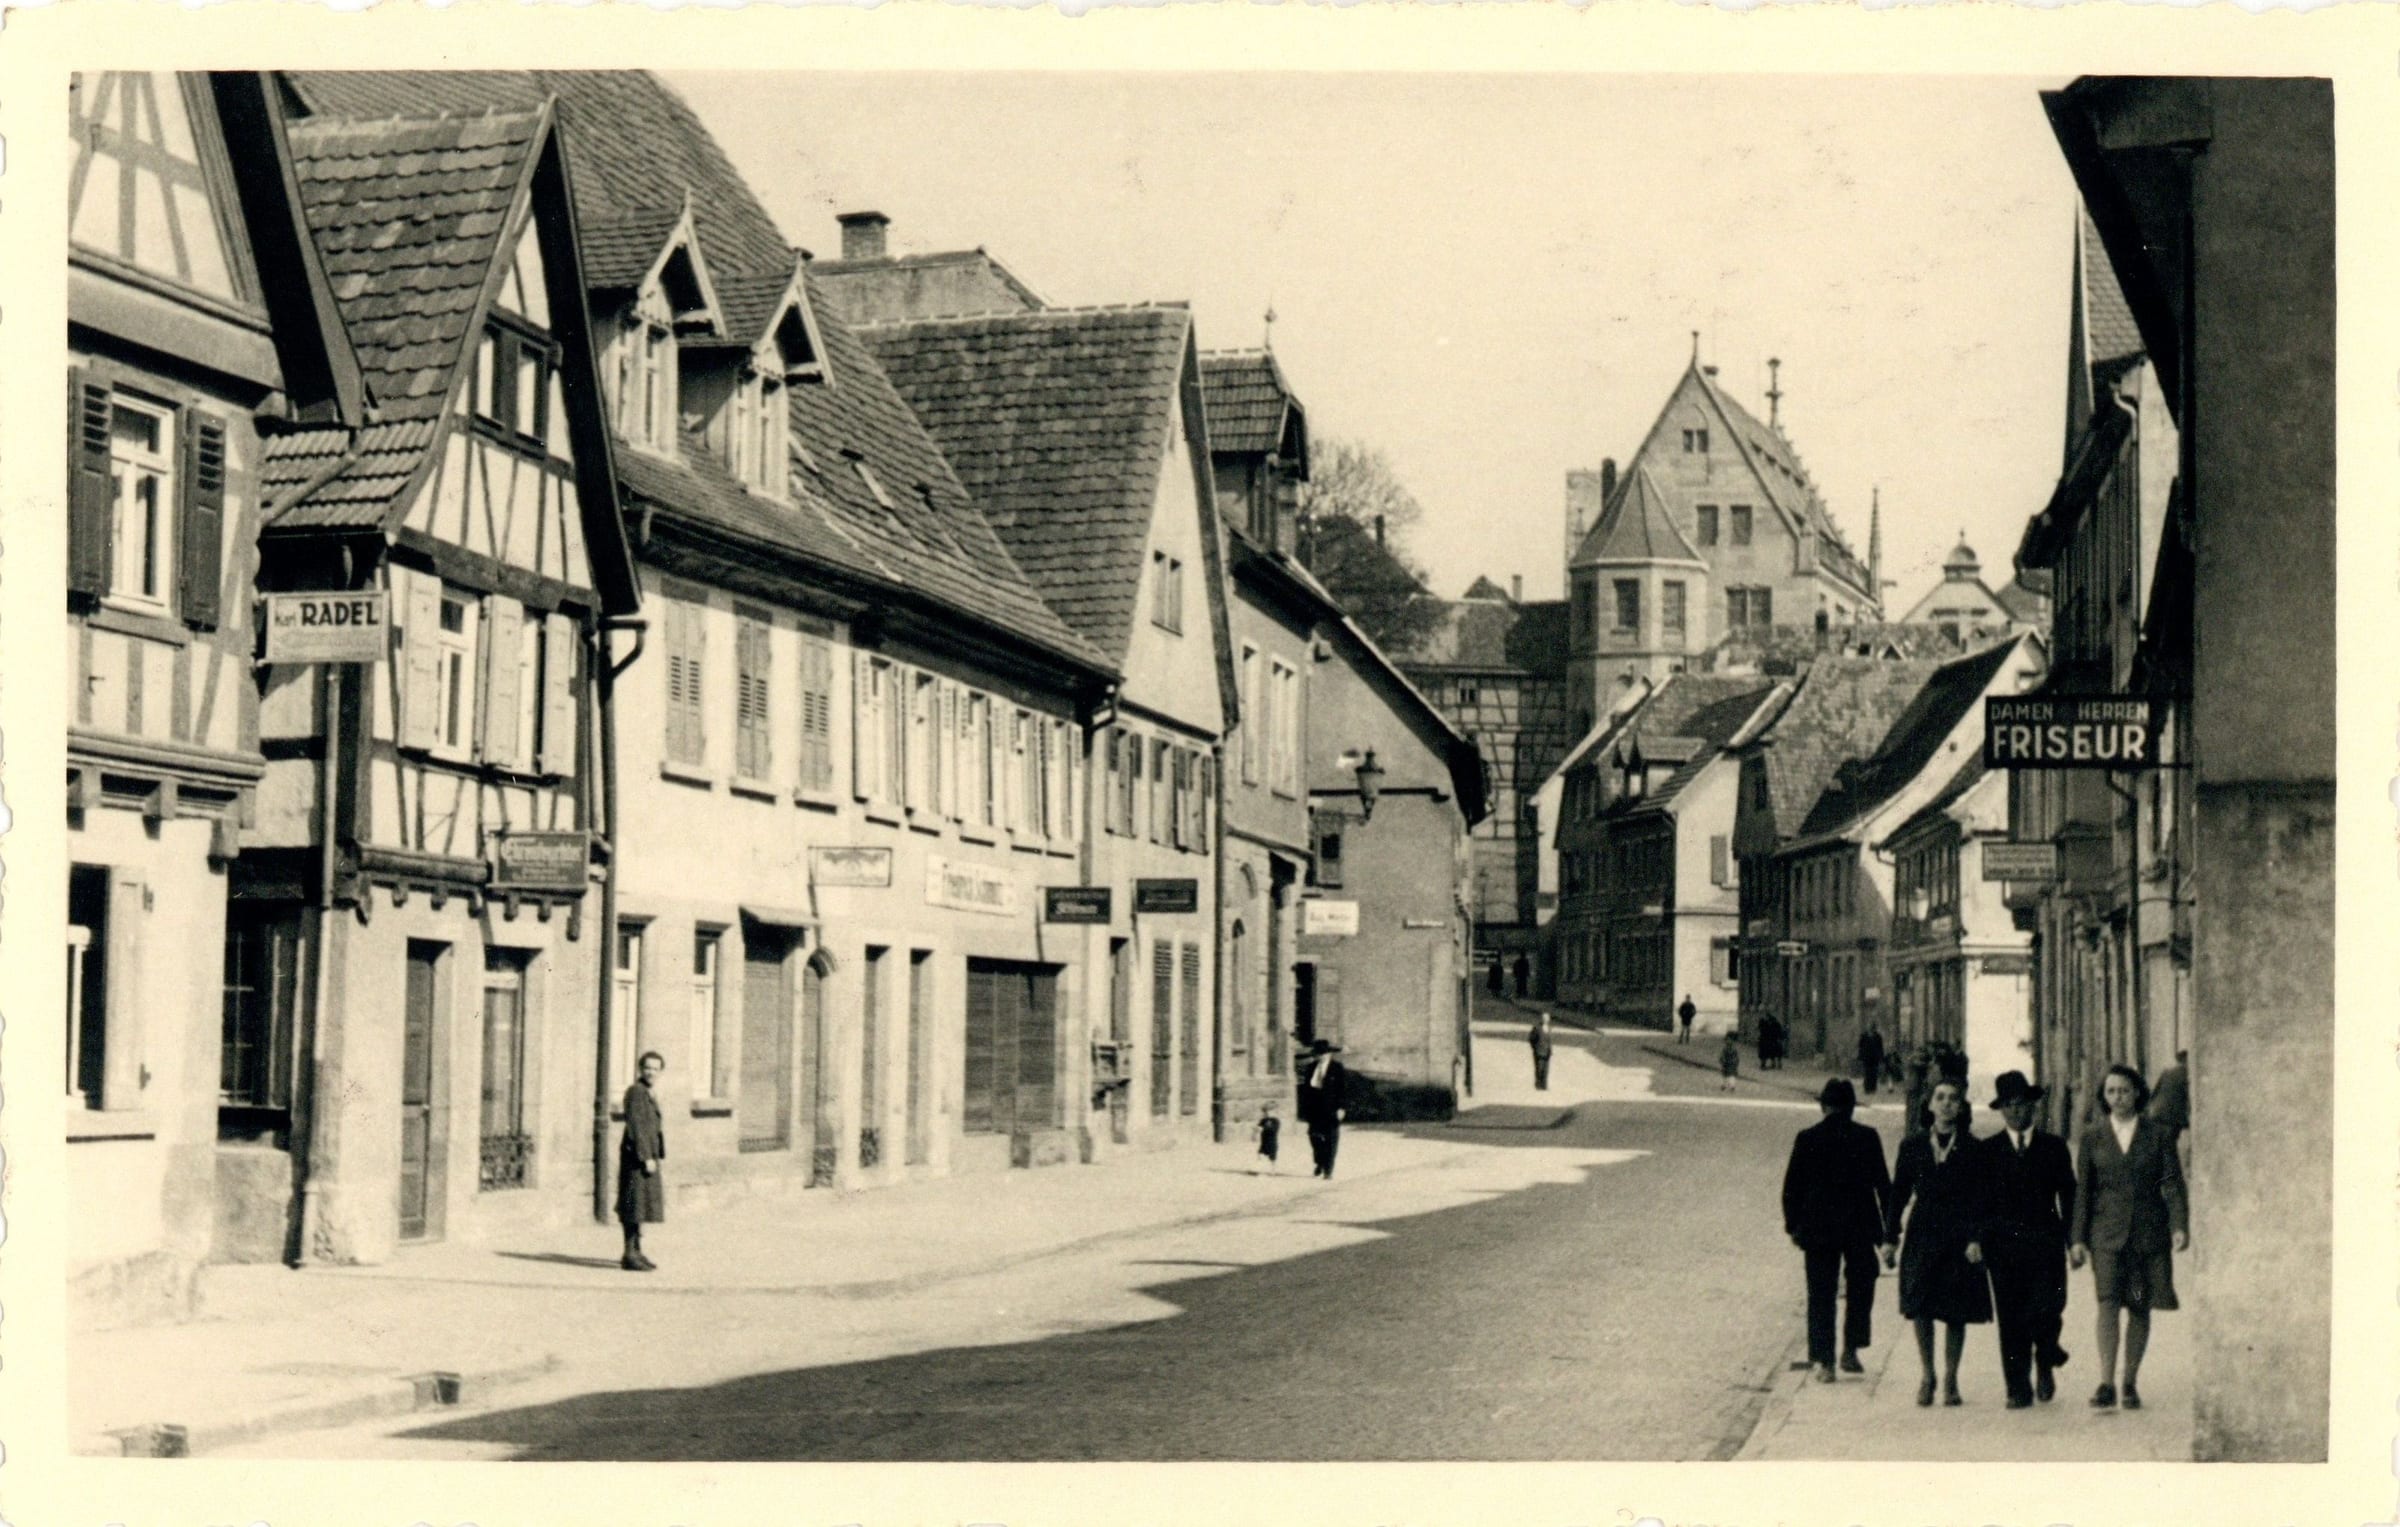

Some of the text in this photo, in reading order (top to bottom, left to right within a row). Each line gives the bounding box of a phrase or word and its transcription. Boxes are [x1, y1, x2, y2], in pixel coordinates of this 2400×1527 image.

[301, 602, 378, 626] RADEL
[1991, 702, 2149, 721] DAMEN HERREN
[1993, 725, 2147, 760] FRISEUR
